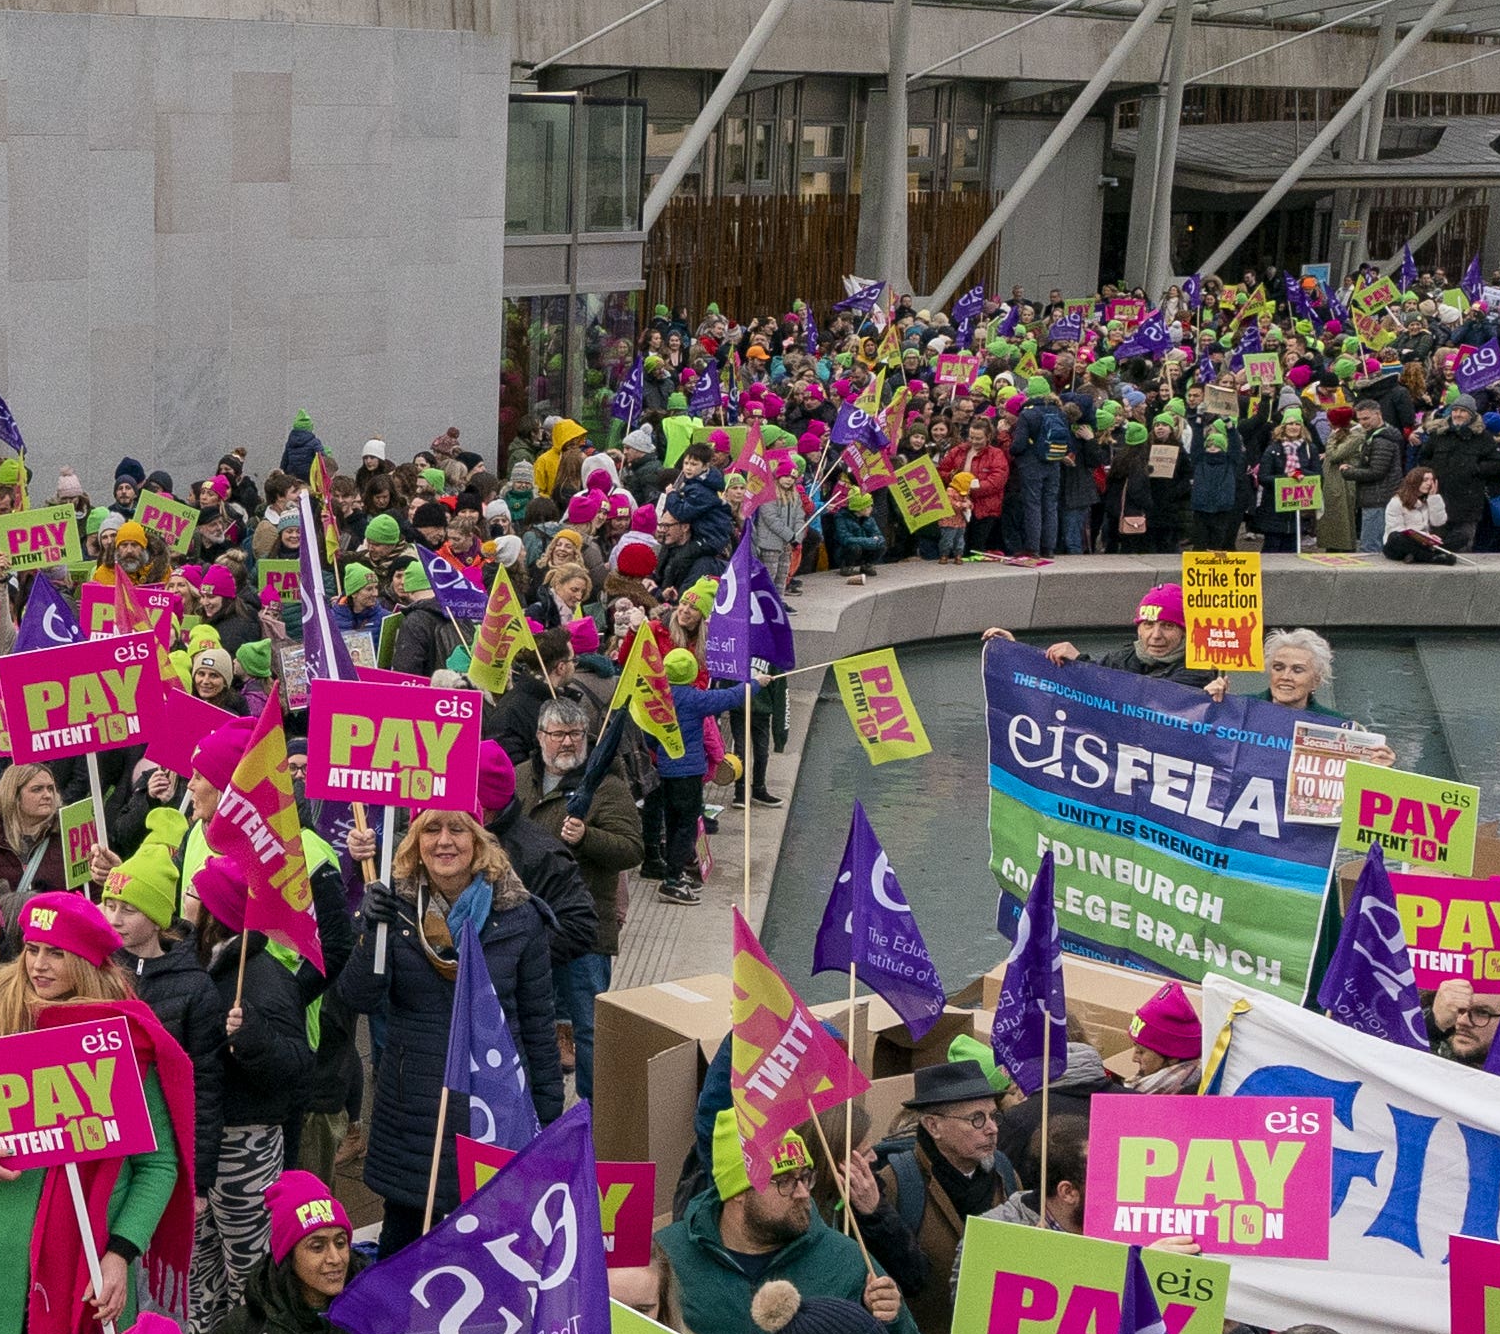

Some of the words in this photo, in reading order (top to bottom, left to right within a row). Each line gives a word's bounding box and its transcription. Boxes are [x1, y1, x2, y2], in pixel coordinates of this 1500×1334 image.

[1195, 556, 1224, 566] Socialist
[1225, 557, 1247, 566] Worker
[1187, 568, 1229, 587] Strike
[1233, 569, 1255, 587] for
[1187, 589, 1257, 609] education
[113, 638, 149, 665] eis
[24, 660, 141, 728] PAY
[1013, 671, 1038, 687] THE
[1039, 678, 1119, 713] EDUCATIONAL
[1121, 704, 1190, 731] INSTITUTE
[1193, 722, 1213, 734] OF
[1295, 754, 1322, 773] ALL
[1296, 777, 1316, 795] TO
[1058, 801, 1113, 830] UNITY
[1116, 818, 1135, 836] IS
[1139, 825, 1229, 869] STRENGTH
[1037, 833, 1223, 924] EDINBURGH
[1002, 858, 1131, 929] COEGE
[1135, 913, 1281, 986] BRANCH
[1265, 1107, 1319, 1134] eis
[1115, 1138, 1306, 1209] PAY
